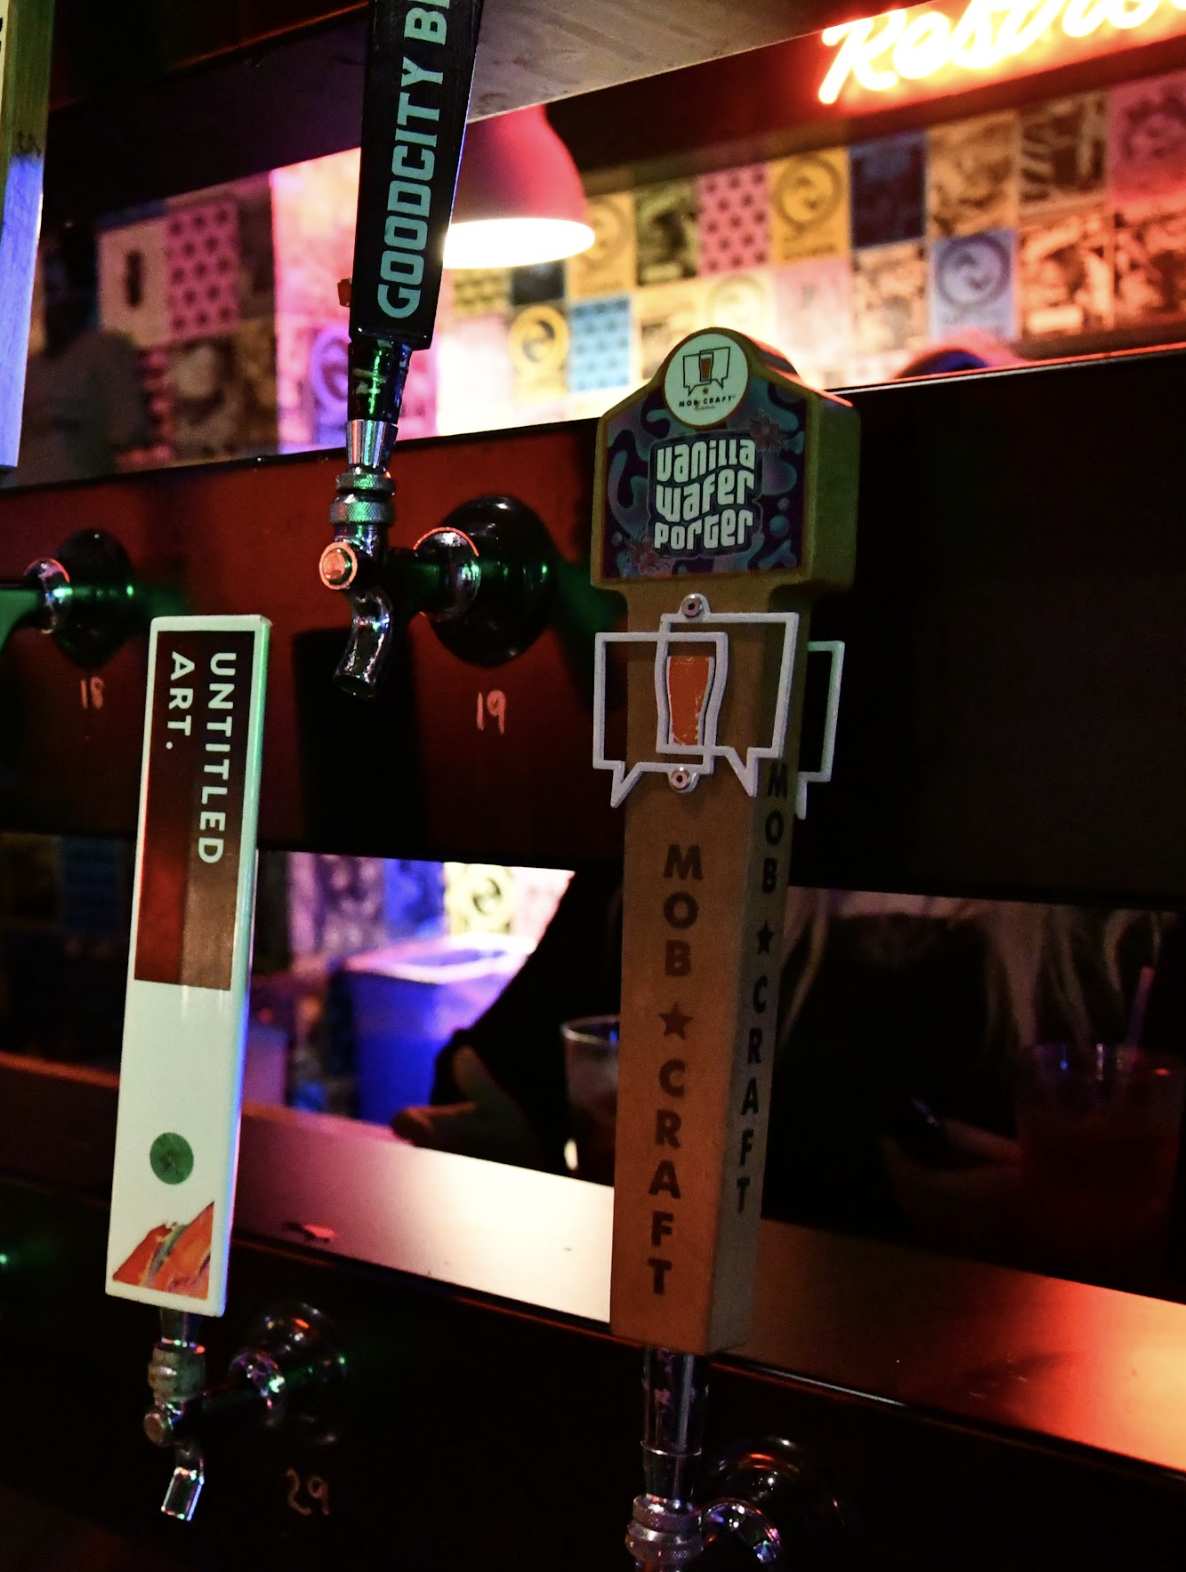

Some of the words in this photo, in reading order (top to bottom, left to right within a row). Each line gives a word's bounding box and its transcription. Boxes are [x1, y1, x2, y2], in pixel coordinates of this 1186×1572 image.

[403, 0, 454, 46] B
[376, 55, 445, 320] GOODCITY
[678, 399, 700, 408] MOB
[653, 508, 754, 551] porter
[655, 468, 756, 523] wafer
[79, 676, 105, 710] 18
[165, 650, 196, 750] ART.
[476, 689, 507, 735] 19
[197, 652, 238, 864] UNTITLED
[760, 761, 789, 895] MOB
[662, 843, 704, 978] MOB
[735, 976, 769, 1216] CRAFT
[647, 1058, 687, 1297] CRAFT
[284, 1467, 331, 1517] 29
